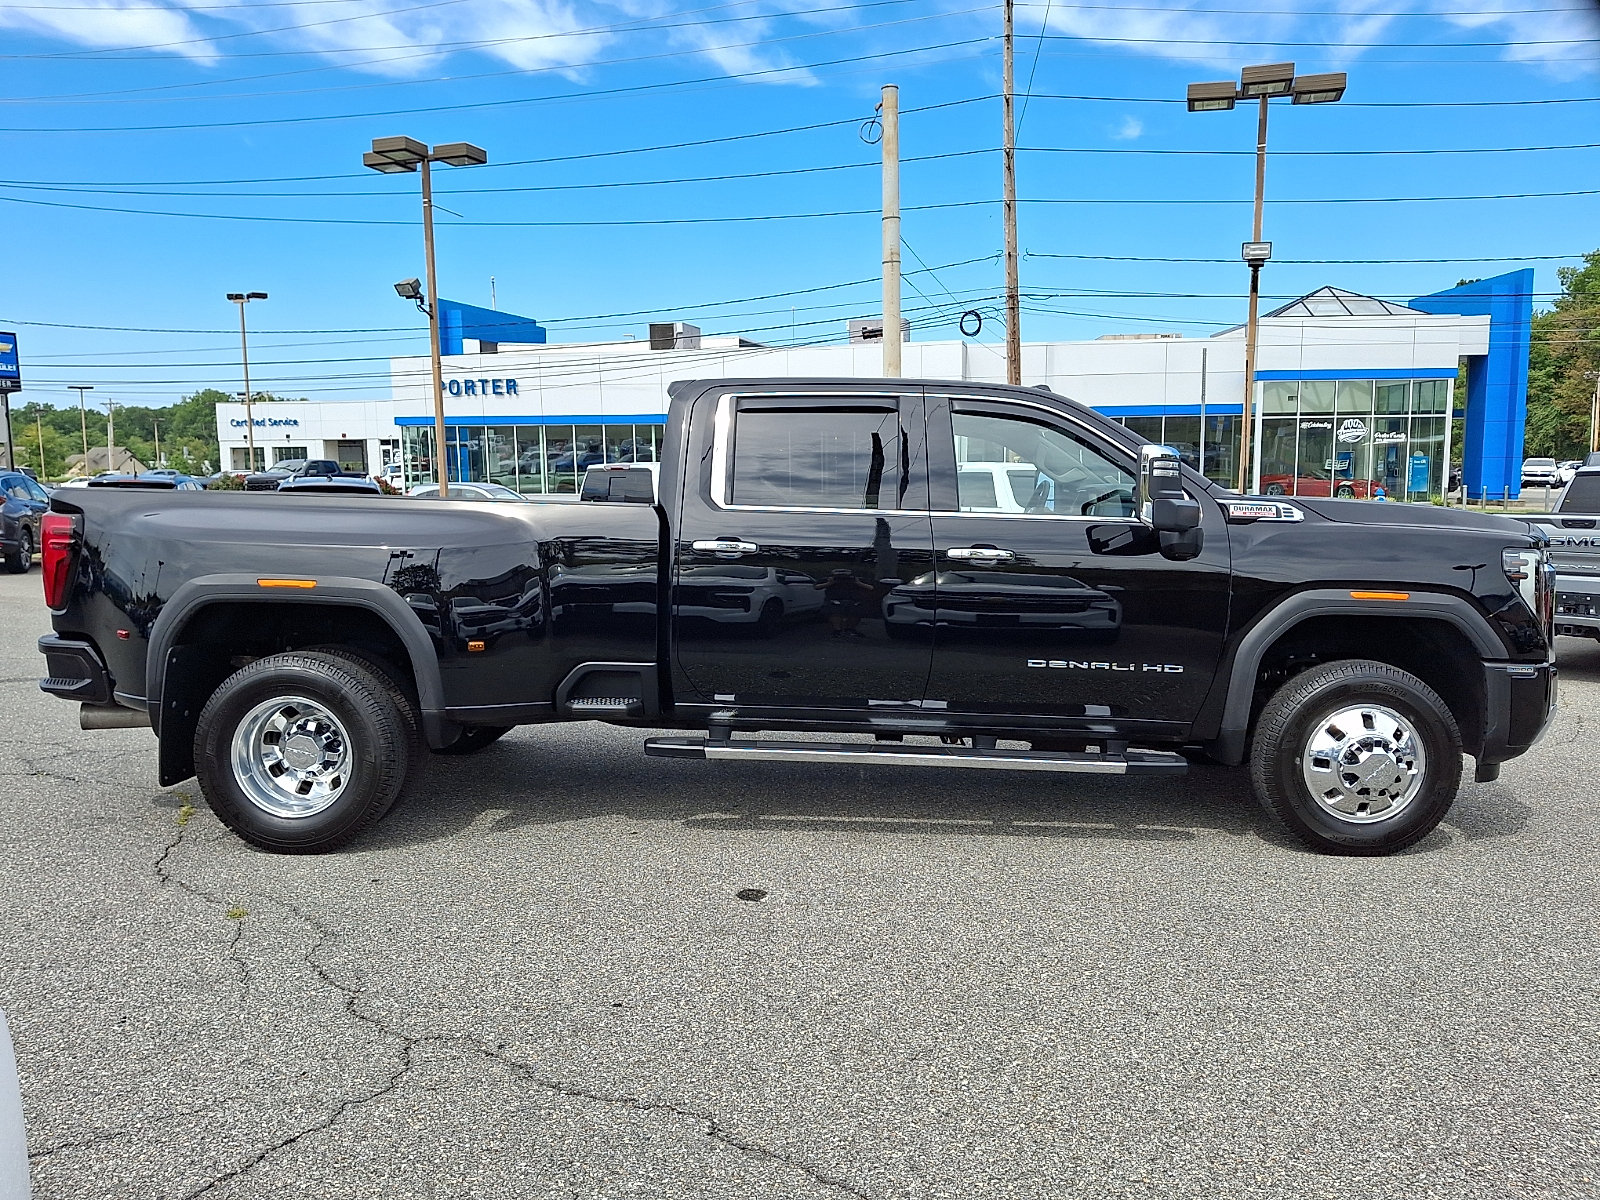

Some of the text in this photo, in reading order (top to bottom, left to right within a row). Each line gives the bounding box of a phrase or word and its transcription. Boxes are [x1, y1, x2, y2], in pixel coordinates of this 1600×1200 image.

[268, 416, 299, 427] Service
[1233, 505, 1273, 513] DURAMAX
[1027, 659, 1184, 673] DENALI HD
